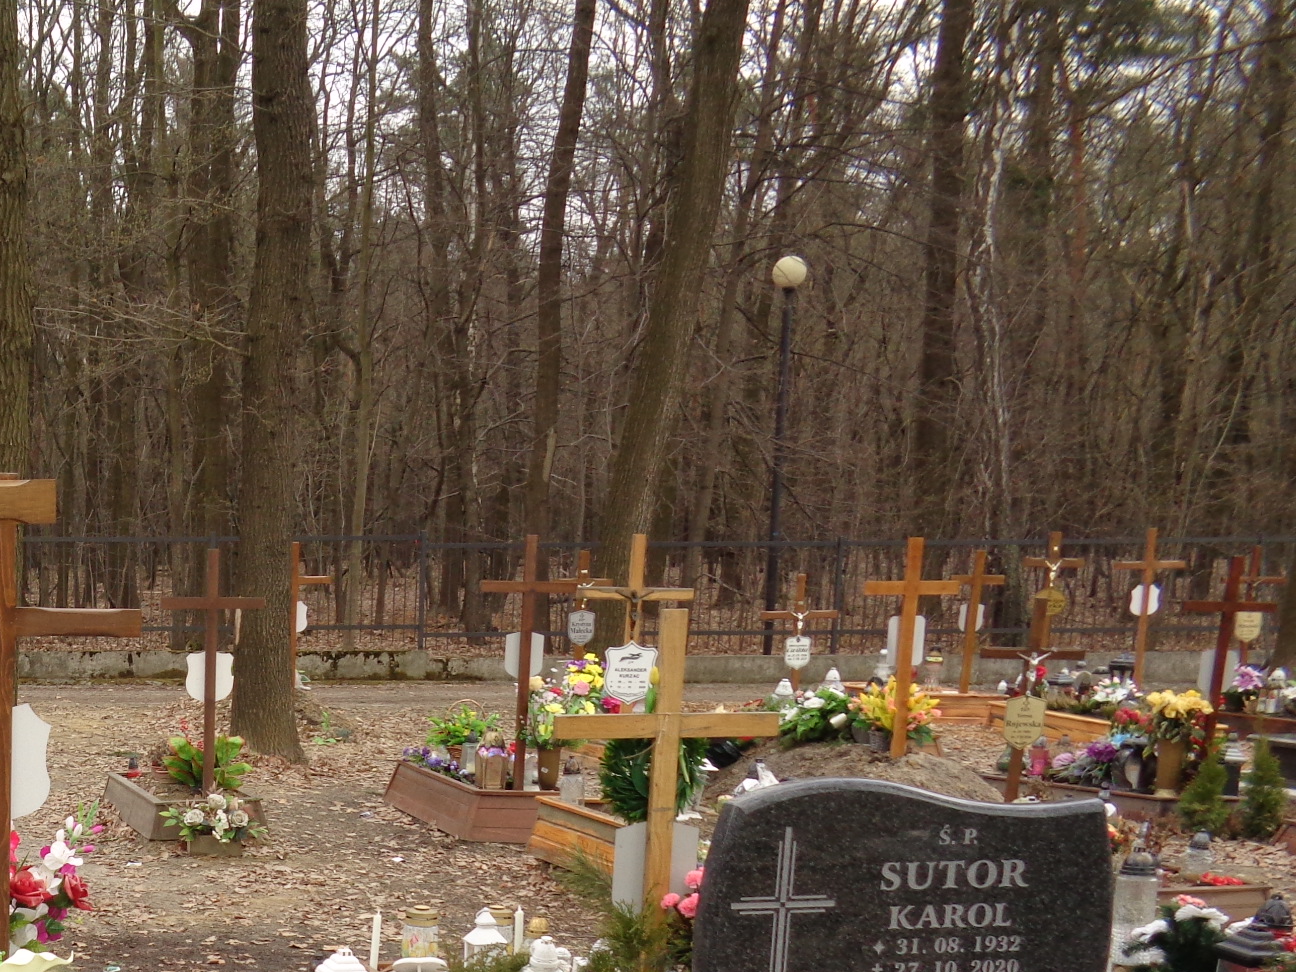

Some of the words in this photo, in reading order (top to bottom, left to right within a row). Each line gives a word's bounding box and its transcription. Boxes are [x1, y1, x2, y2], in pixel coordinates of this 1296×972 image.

[880, 858, 1030, 891] SUTOR
[888, 902, 1012, 930] KAROL
[895, 938, 927, 955] 31.
[934, 936, 964, 954] 08.
[974, 935, 1022, 952] 1932
